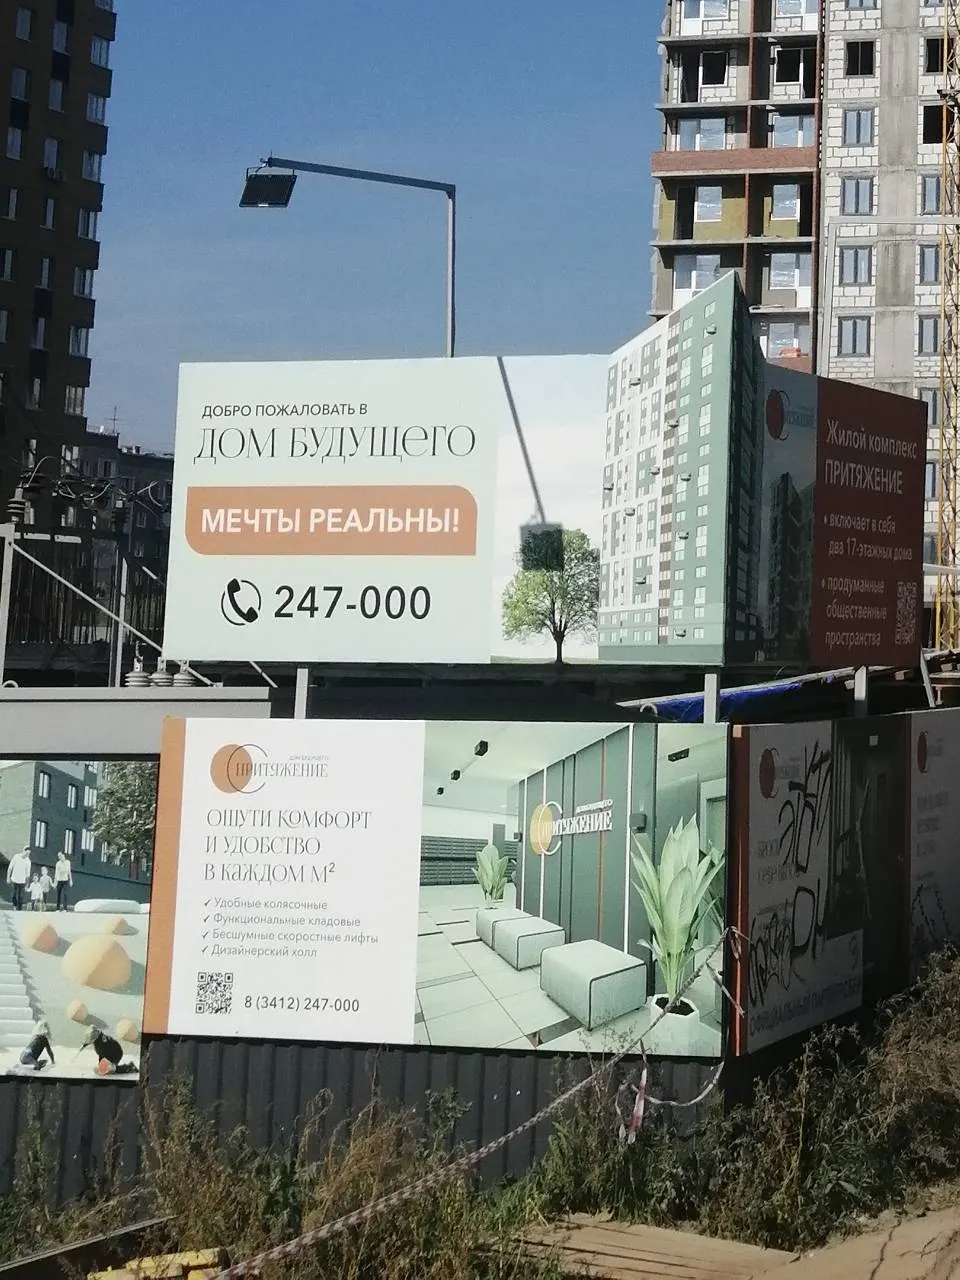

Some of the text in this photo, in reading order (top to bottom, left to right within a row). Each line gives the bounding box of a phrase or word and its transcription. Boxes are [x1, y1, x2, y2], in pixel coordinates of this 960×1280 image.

[202, 404, 368, 419] ДОБРО ПОЖАЛОВАТЬ В
[193, 427, 279, 464] ДОМ
[826, 418, 918, 459] Жилой комплекс
[824, 458, 903, 495] ПРИТЯЖЕНИЕ
[201, 507, 460, 533] МЕЧТЫ РЕАЛЬНЫ!
[829, 513, 896, 533] включает в себя
[828, 536, 913, 562] два 17-этажных дома
[827, 577, 885, 598] продуманные
[274, 585, 431, 620] 247-000
[825, 598, 887, 622] общественные
[824, 631, 881, 651] пространства
[235, 762, 329, 777] ПРИТЯЖЕНИЕ
[205, 835, 321, 856] И УДОБСТВО
[204, 863, 215, 881] В
[214, 896, 328, 911] Удобные колясочные
[213, 912, 361, 928] Функциональные кладовые
[212, 928, 379, 946] Бесшумные скоростные лифты
[211, 943, 317, 958] Дизайнерский холл
[244, 995, 360, 1012] 8 (3412) 247-000
